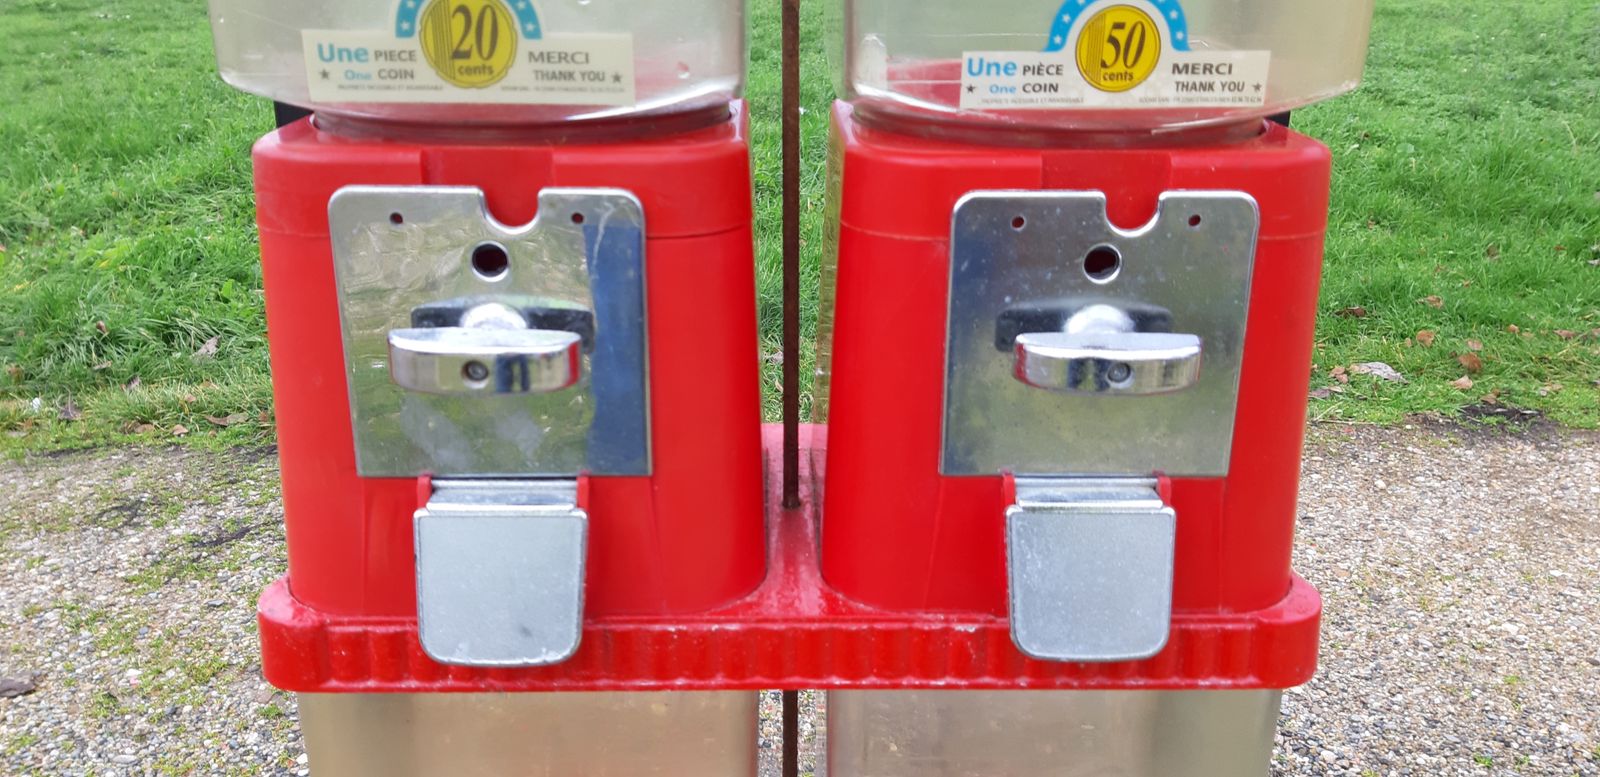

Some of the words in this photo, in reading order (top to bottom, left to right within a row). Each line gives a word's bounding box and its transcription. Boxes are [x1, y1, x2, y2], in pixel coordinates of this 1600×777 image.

[452, 4, 498, 61] 20
[1101, 21, 1146, 69] 50
[317, 43, 369, 63] Une
[528, 51, 590, 64] MERCI
[457, 64, 494, 76] cents
[967, 57, 1017, 77] Une
[1022, 62, 1064, 76] PIÈCE
[1171, 63, 1233, 75] MERCI
[344, 69, 371, 80] One
[378, 68, 414, 80] COIN
[534, 69, 576, 82] THANK
[581, 71, 605, 82] YOU
[1103, 71, 1134, 82] cents
[989, 84, 1016, 94] One
[1022, 83, 1059, 93] COIN
[1175, 81, 1215, 92] THANK
[1220, 81, 1245, 92] YOU
